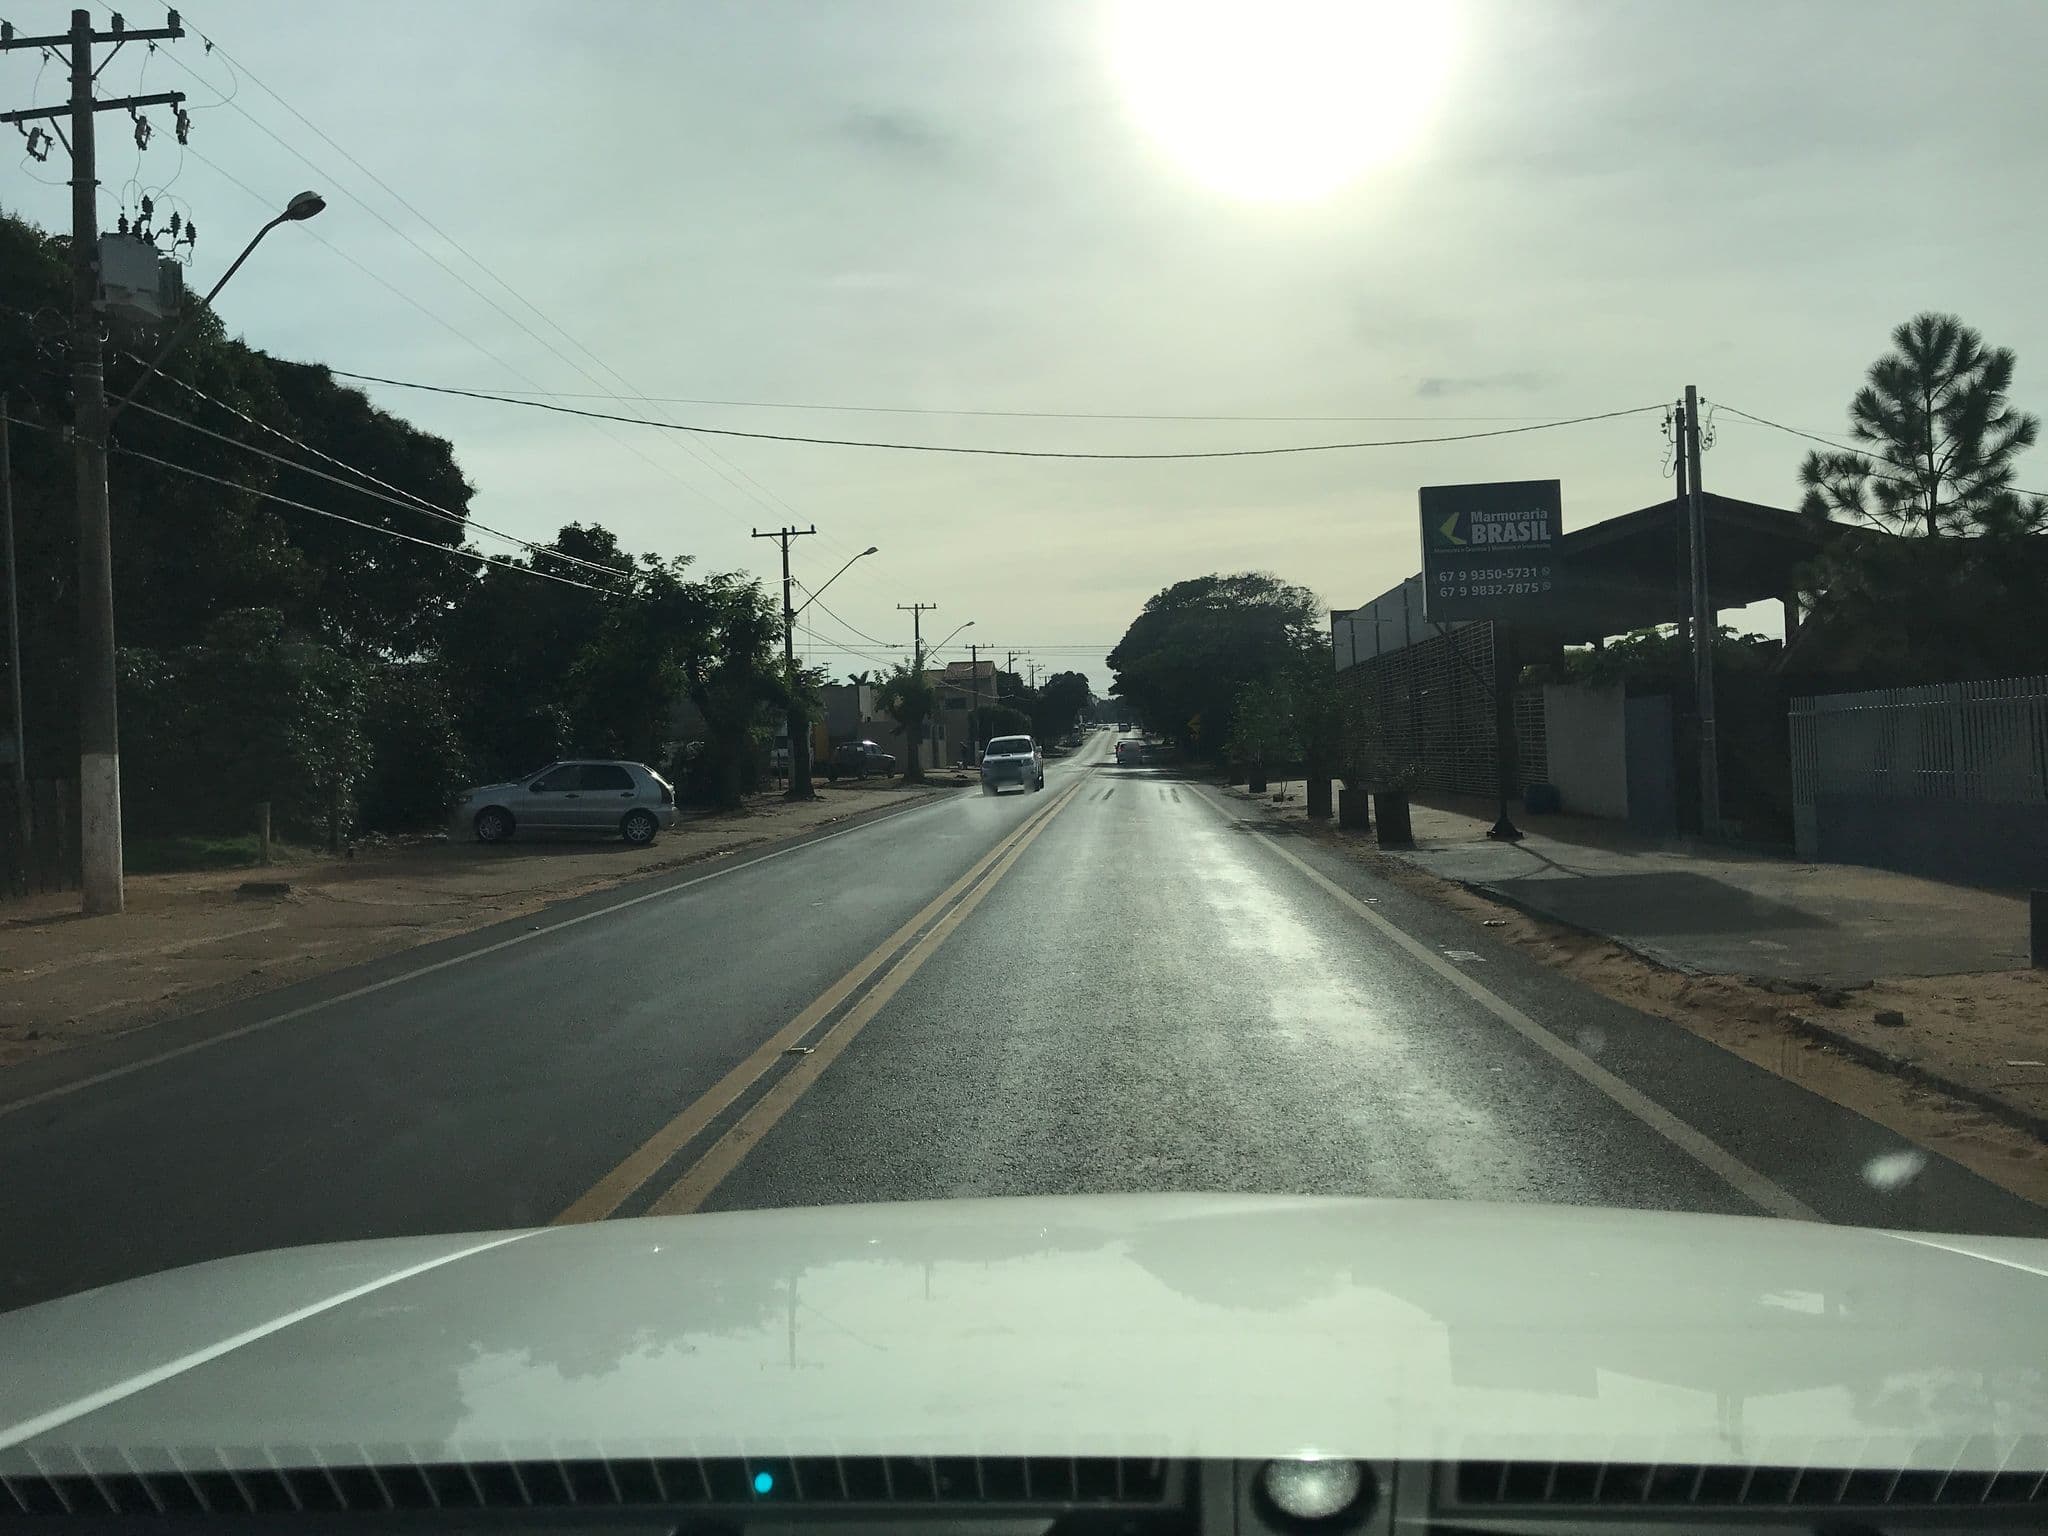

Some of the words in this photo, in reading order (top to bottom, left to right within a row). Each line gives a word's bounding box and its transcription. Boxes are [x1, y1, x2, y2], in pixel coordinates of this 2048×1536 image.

[1470, 507, 1548, 523] Marmoraria
[1471, 521, 1552, 544] BRASIL
[1439, 571, 1454, 582] 67
[1459, 571, 1467, 581] 9
[1471, 567, 1537, 581] 9350-5731
[1440, 587, 1454, 597] 67
[1459, 586, 1467, 596] 9
[1471, 582, 1539, 596] 9832-7875
